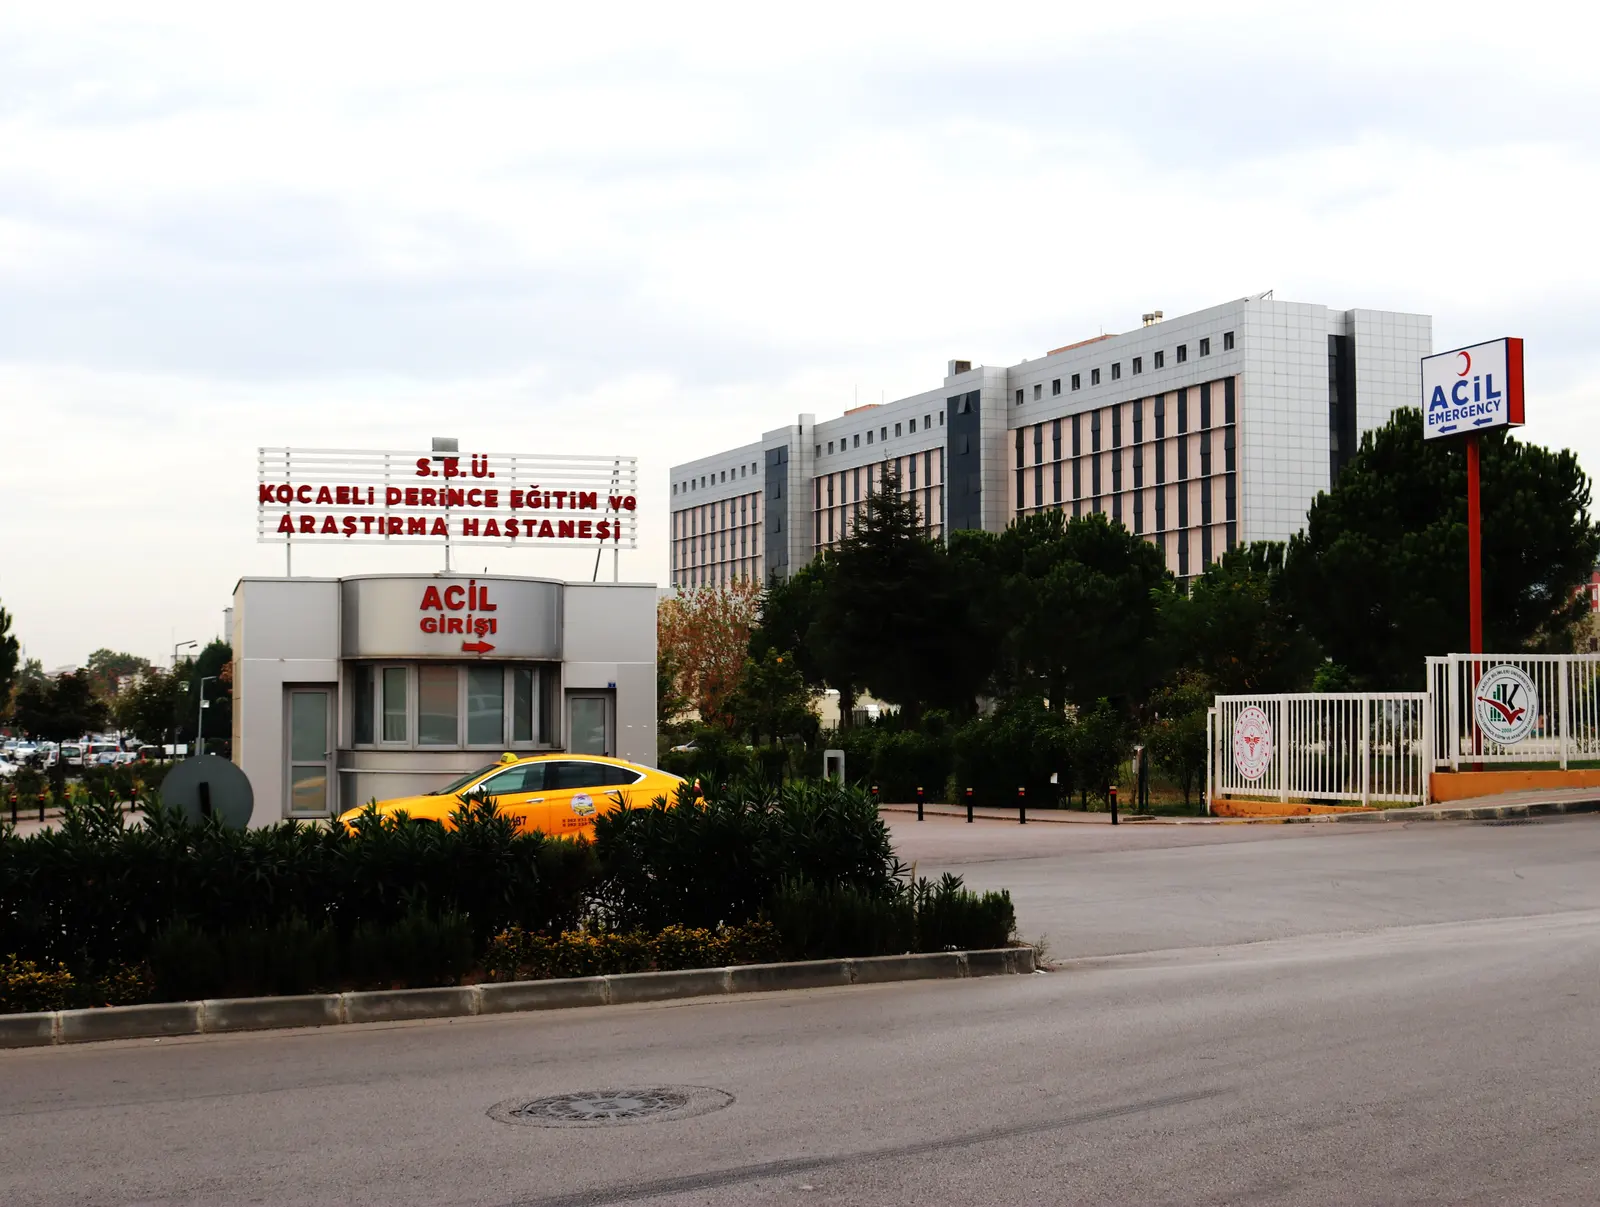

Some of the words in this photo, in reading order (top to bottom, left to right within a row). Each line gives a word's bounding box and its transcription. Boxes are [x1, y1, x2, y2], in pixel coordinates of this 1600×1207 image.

[1428, 399, 1501, 426] EMERGENCY
[416, 453, 495, 478] S.B.Ü.
[609, 495, 637, 511] ve
[277, 514, 449, 538] ARAŞTIRMA
